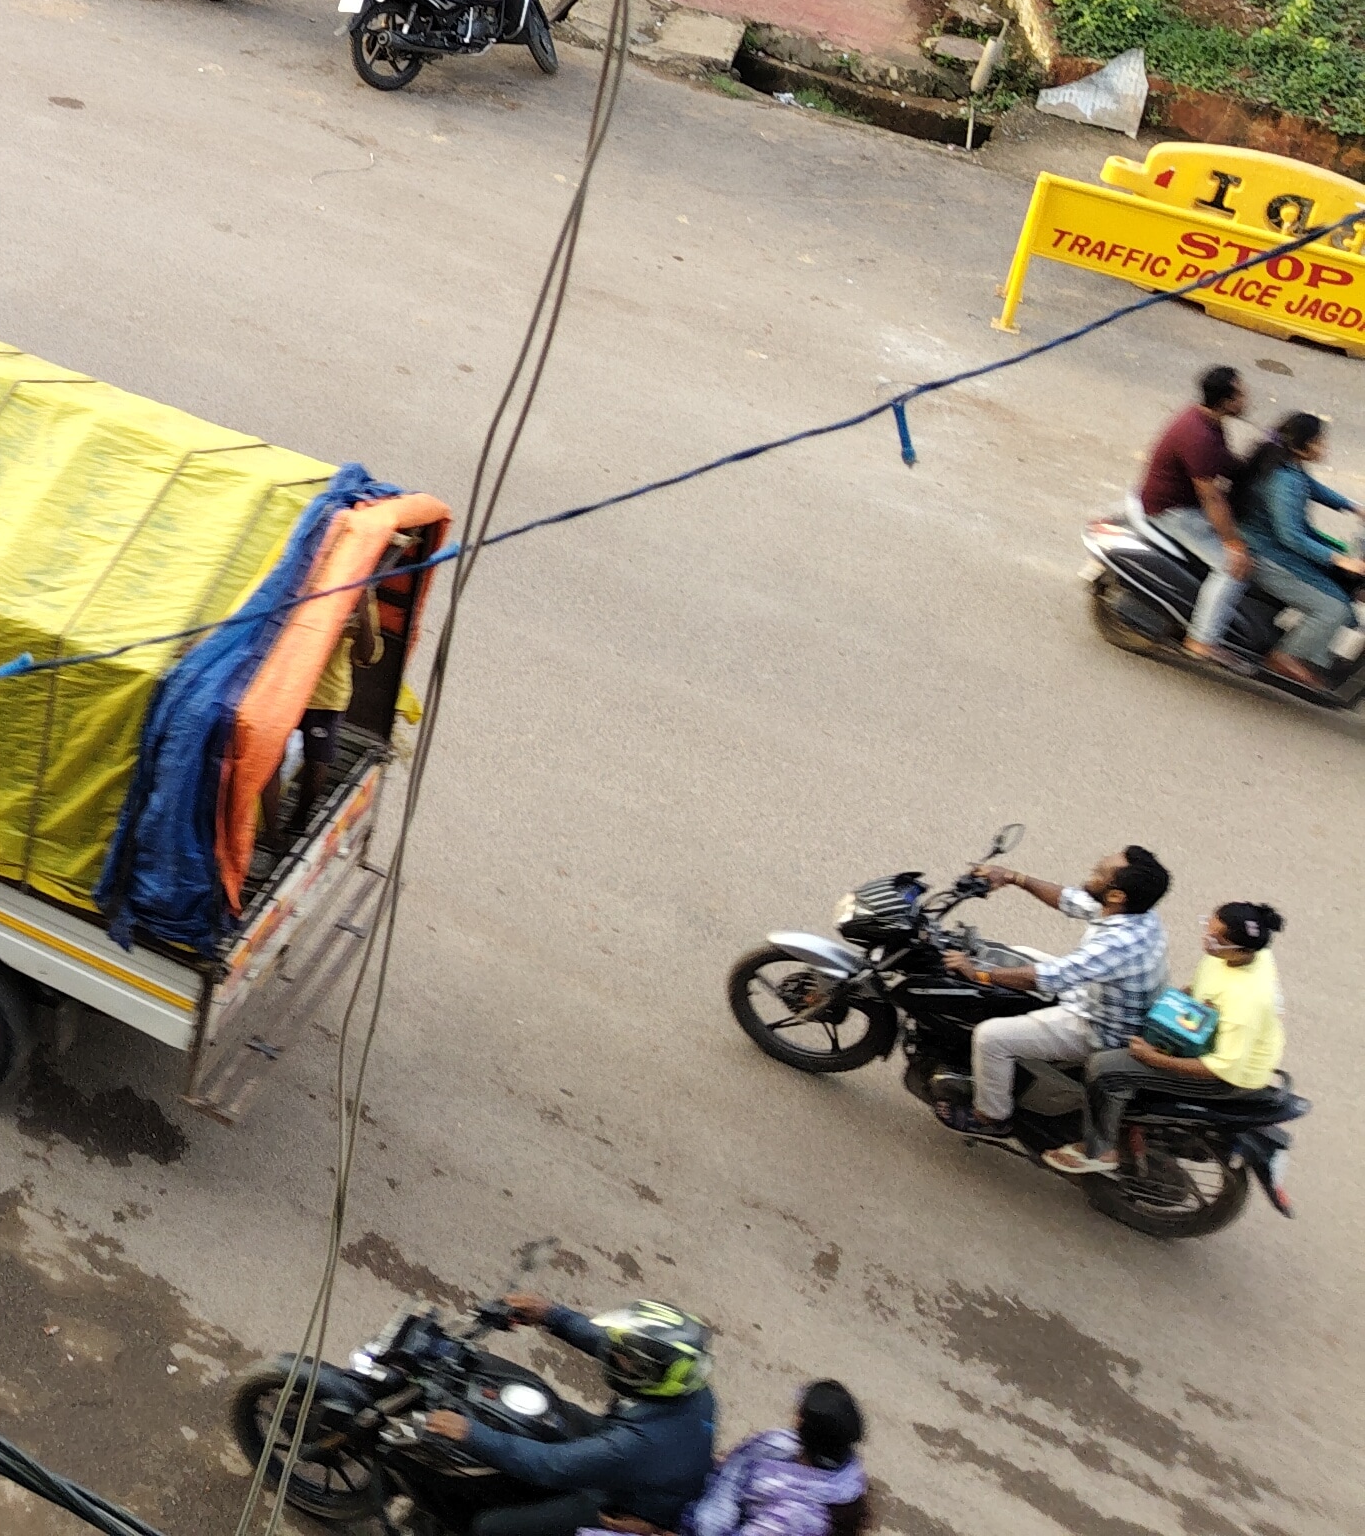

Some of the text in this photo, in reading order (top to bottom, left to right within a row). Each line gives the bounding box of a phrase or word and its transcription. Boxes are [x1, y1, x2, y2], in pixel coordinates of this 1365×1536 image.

[1052, 227, 1172, 278] TRAFFIC
[1175, 262, 1282, 308] POLICE
[1177, 231, 1355, 290] STOP
